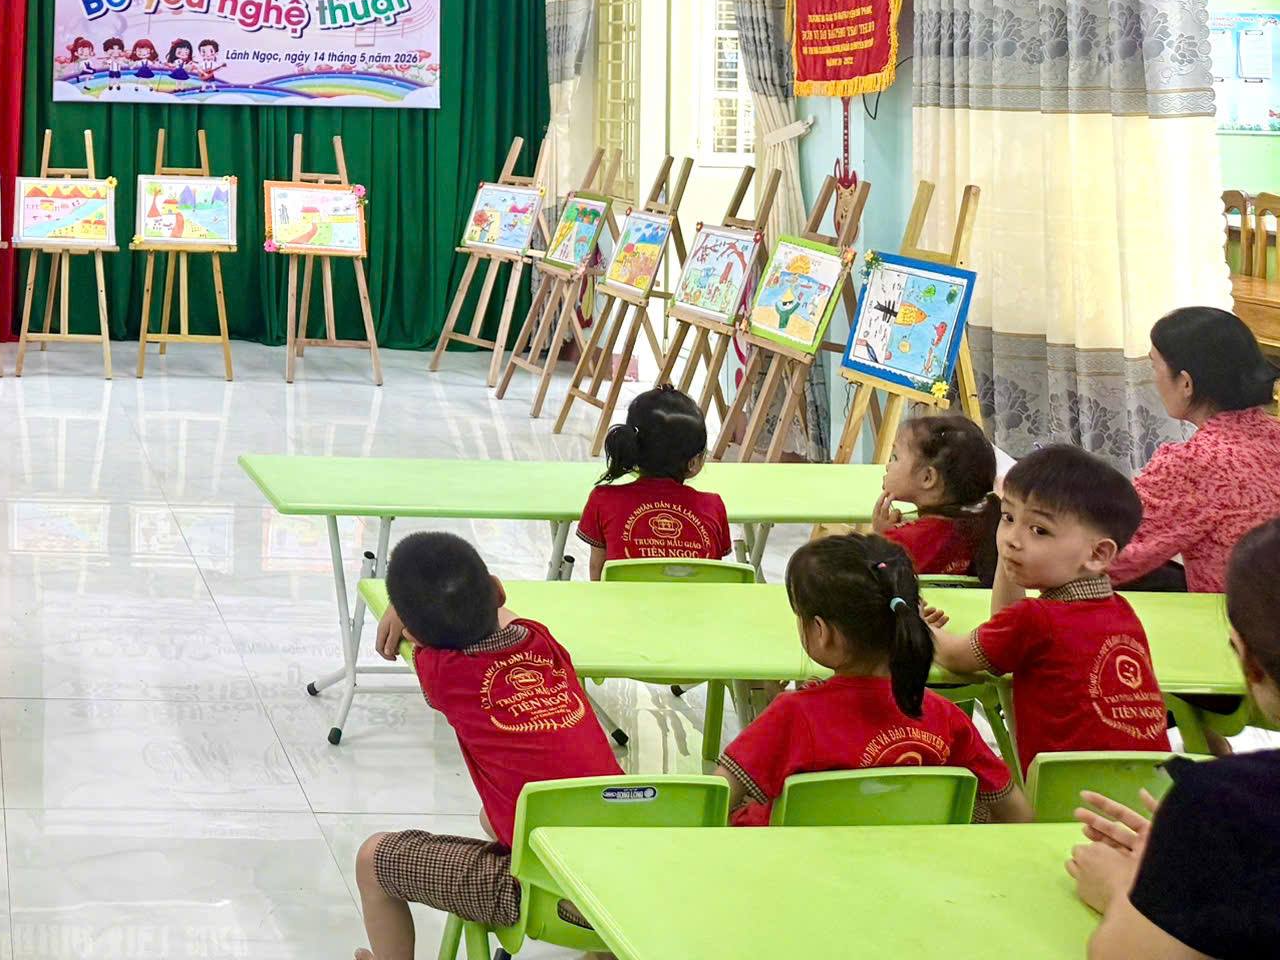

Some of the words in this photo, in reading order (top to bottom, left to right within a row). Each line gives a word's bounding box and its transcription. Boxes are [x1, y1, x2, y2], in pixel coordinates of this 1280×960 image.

[225, 50, 249, 61] Lãnh
[252, 50, 281, 63] Ngọc,
[285, 51, 311, 64] ngày
[313, 52, 325, 62] 14
[327, 51, 357, 64] tháng
[368, 53, 391, 63] năm
[394, 53, 418, 64] 2026
[639, 546, 666, 557] TIÊN
